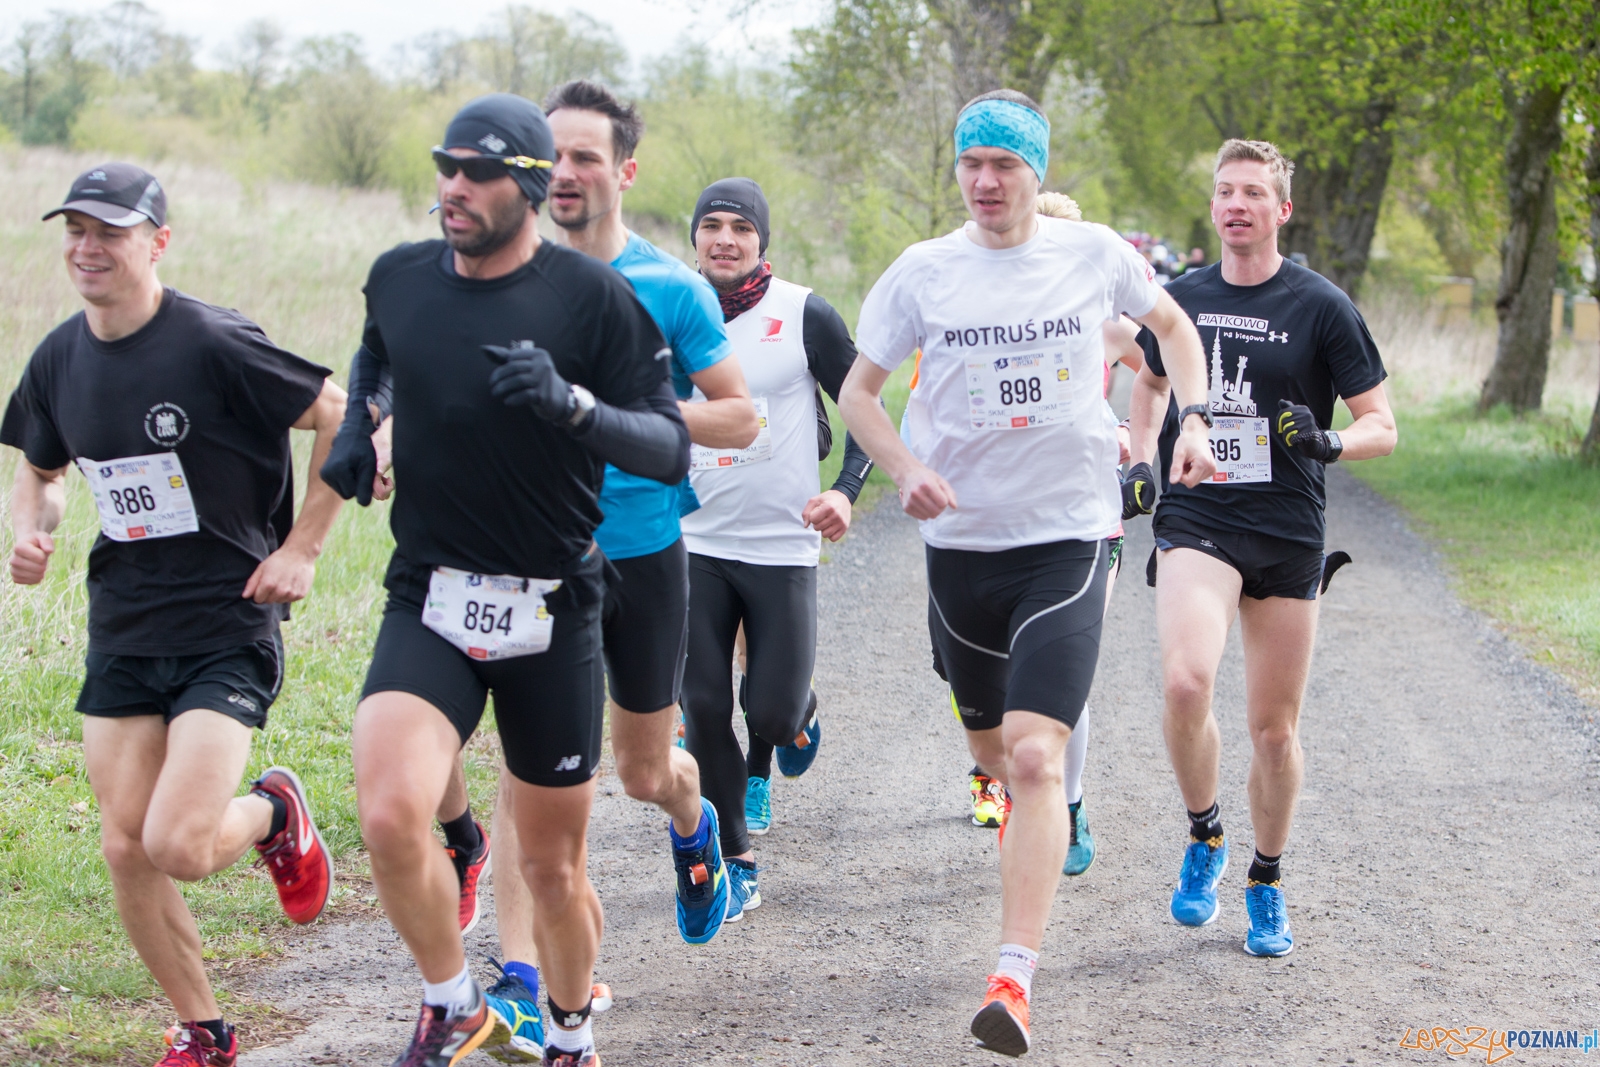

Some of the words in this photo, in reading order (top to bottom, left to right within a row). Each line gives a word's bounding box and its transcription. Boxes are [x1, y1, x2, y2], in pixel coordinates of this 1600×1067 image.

[944, 318, 1037, 347] PIOTRUŚ
[1043, 316, 1082, 339] PAN
[1234, 332, 1265, 344] biegowo
[999, 376, 1042, 406] 898
[988, 409, 1004, 417] 5KM
[1037, 403, 1057, 412] 10KM
[110, 485, 156, 516] 886
[464, 600, 513, 636] 854
